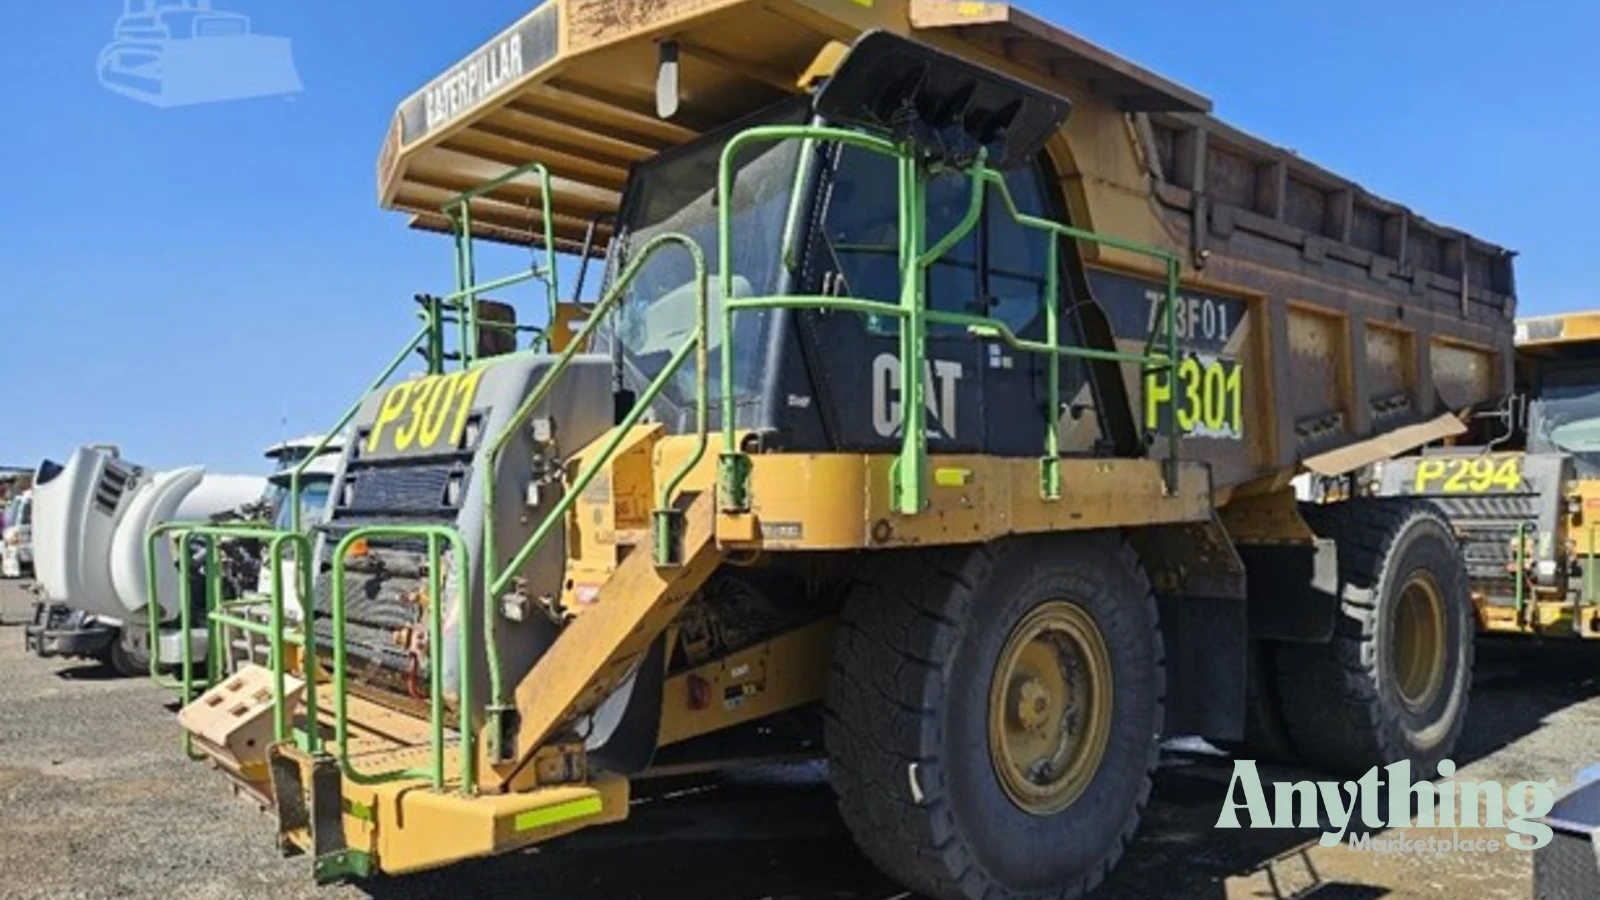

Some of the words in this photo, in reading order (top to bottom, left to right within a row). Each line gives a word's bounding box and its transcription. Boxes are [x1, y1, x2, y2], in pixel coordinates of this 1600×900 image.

[425, 32, 523, 129] CATERPILLAR
[368, 367, 483, 452] P301
[1145, 357, 1242, 434] P301
[1415, 457, 1522, 493] P294
